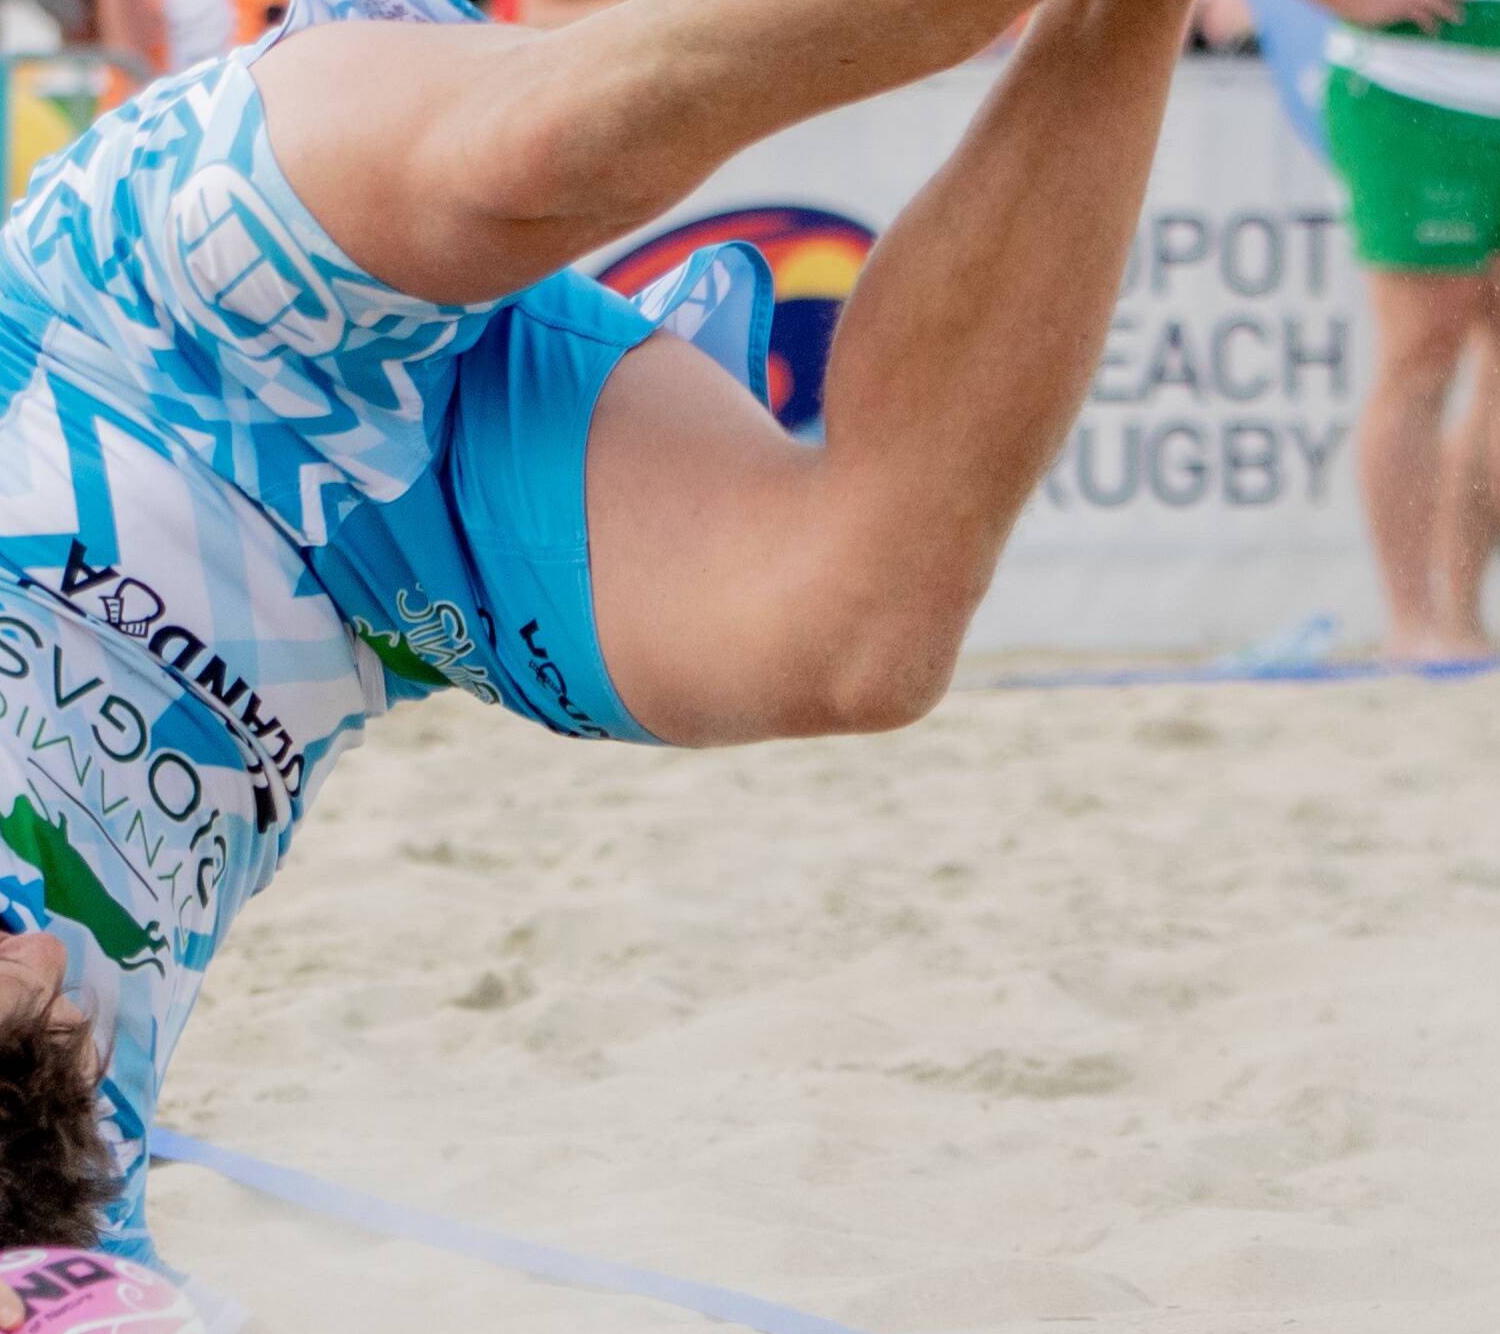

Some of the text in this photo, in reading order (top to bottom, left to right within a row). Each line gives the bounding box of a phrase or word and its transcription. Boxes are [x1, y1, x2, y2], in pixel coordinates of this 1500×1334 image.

[1124, 210, 1338, 299] POT
[1094, 314, 1348, 402] EACH
[1045, 418, 1348, 507] UGBY
